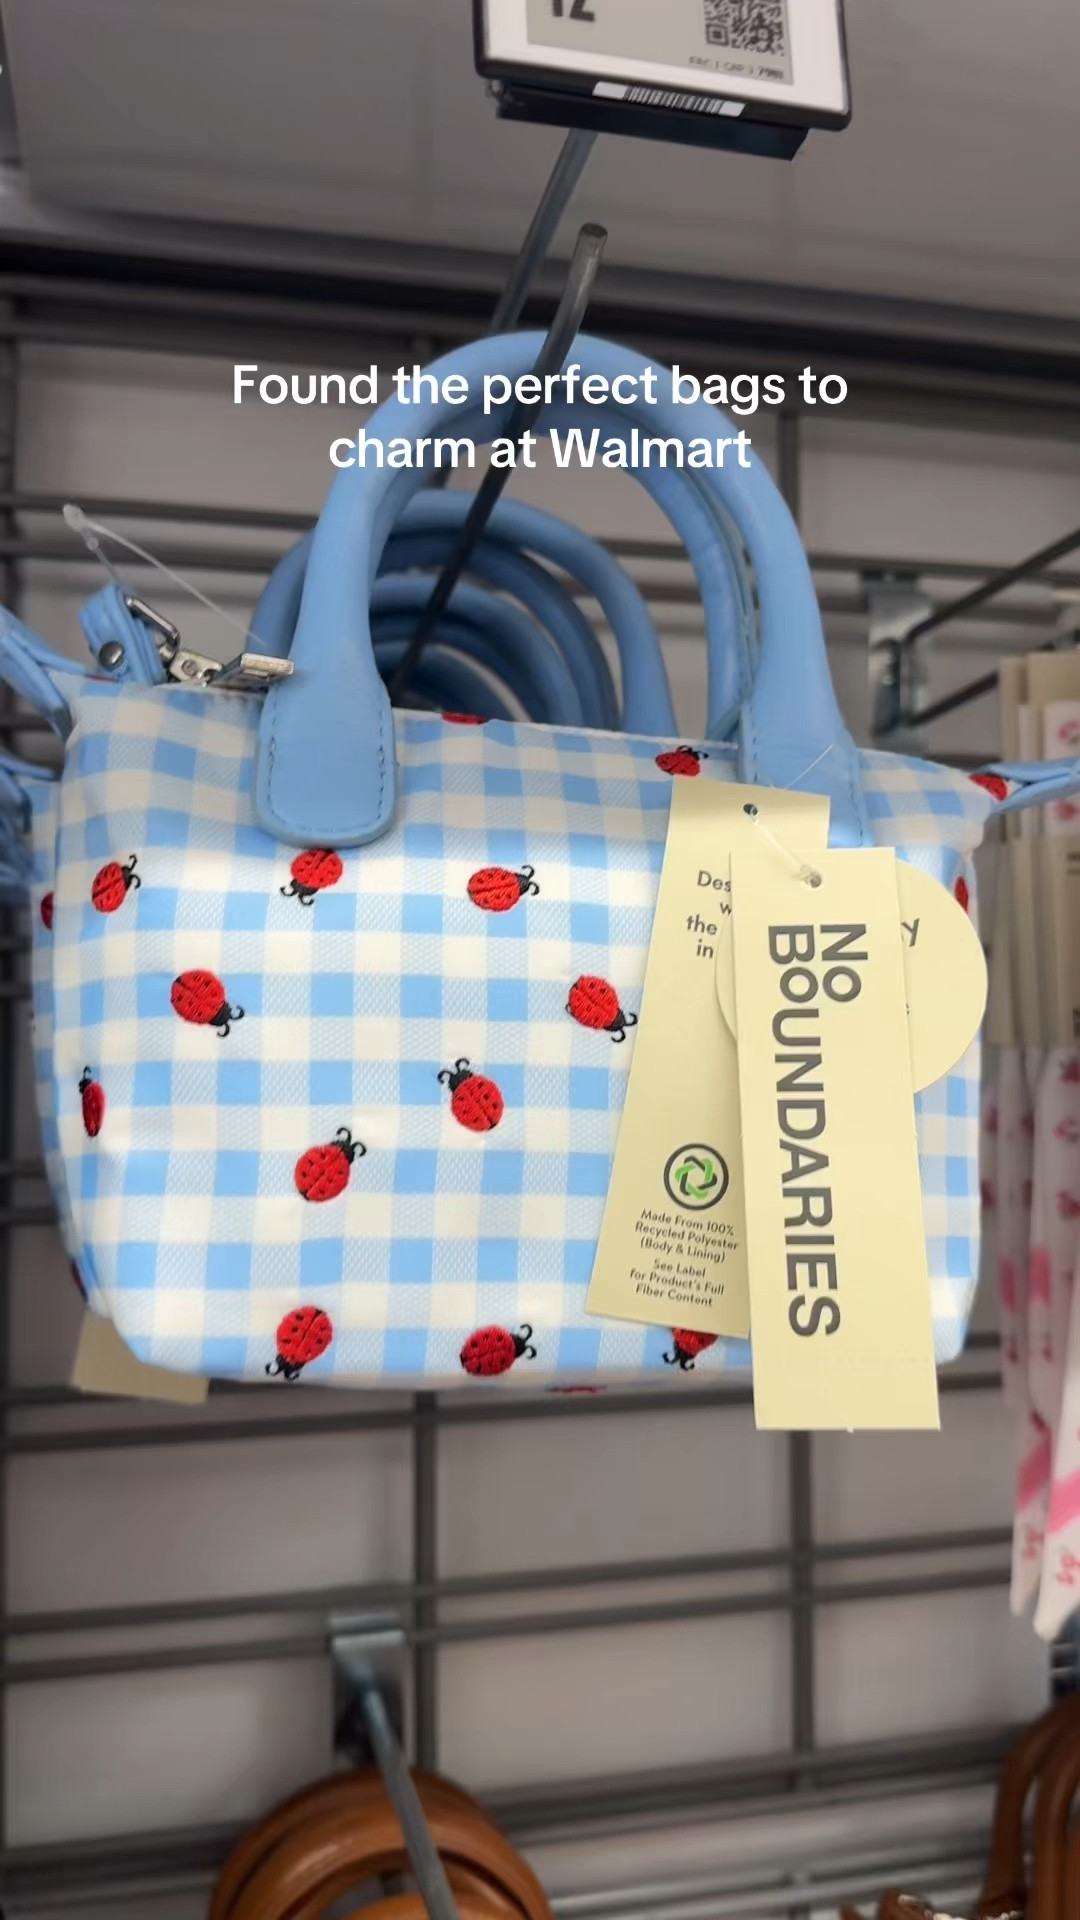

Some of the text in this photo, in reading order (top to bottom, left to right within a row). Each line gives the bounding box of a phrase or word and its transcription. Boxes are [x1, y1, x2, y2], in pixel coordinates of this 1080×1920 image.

[686, 914, 718, 935] the
[696, 938, 714, 958] in
[820, 923, 869, 1002] NO
[768, 923, 842, 1337] BOUNDARIES
[635, 1221, 739, 1250] Recycled Polyester
[640, 1209, 735, 1236] Made From 100%
[641, 1236, 726, 1263] (Body & Lining)
[653, 1258, 706, 1278] See Label
[630, 1269, 725, 1295] for Product's Full
[636, 1285, 713, 1307] Fiber Content
